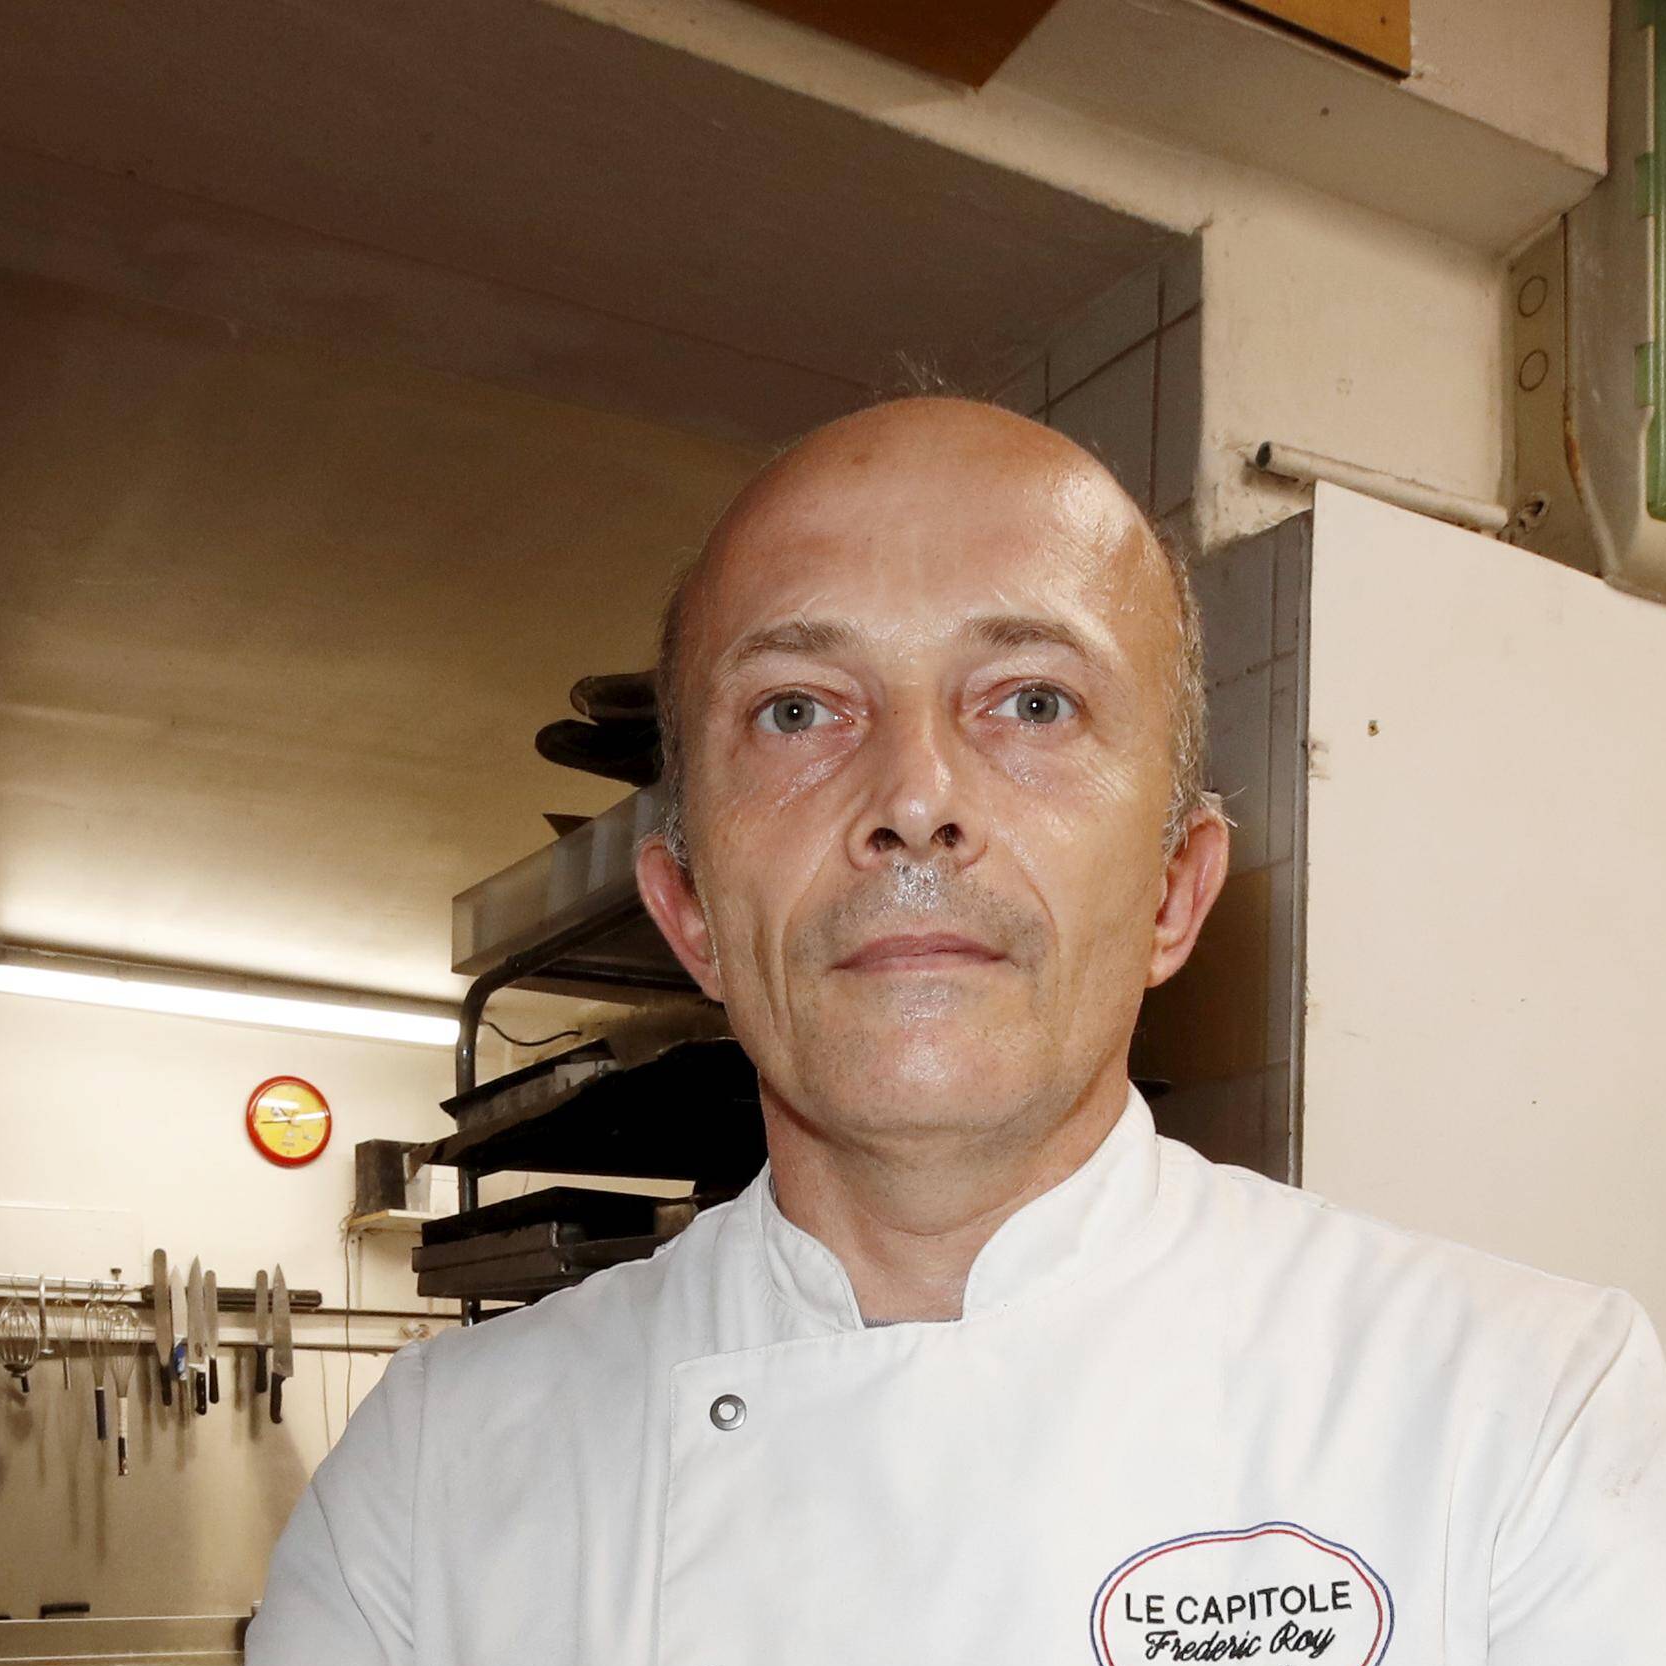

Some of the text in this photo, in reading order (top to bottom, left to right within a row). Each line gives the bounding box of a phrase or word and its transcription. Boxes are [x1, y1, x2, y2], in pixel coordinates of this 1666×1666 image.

[1125, 1580, 1353, 1625] LE CAPITOLE
[1269, 1619, 1337, 1660] Roy
